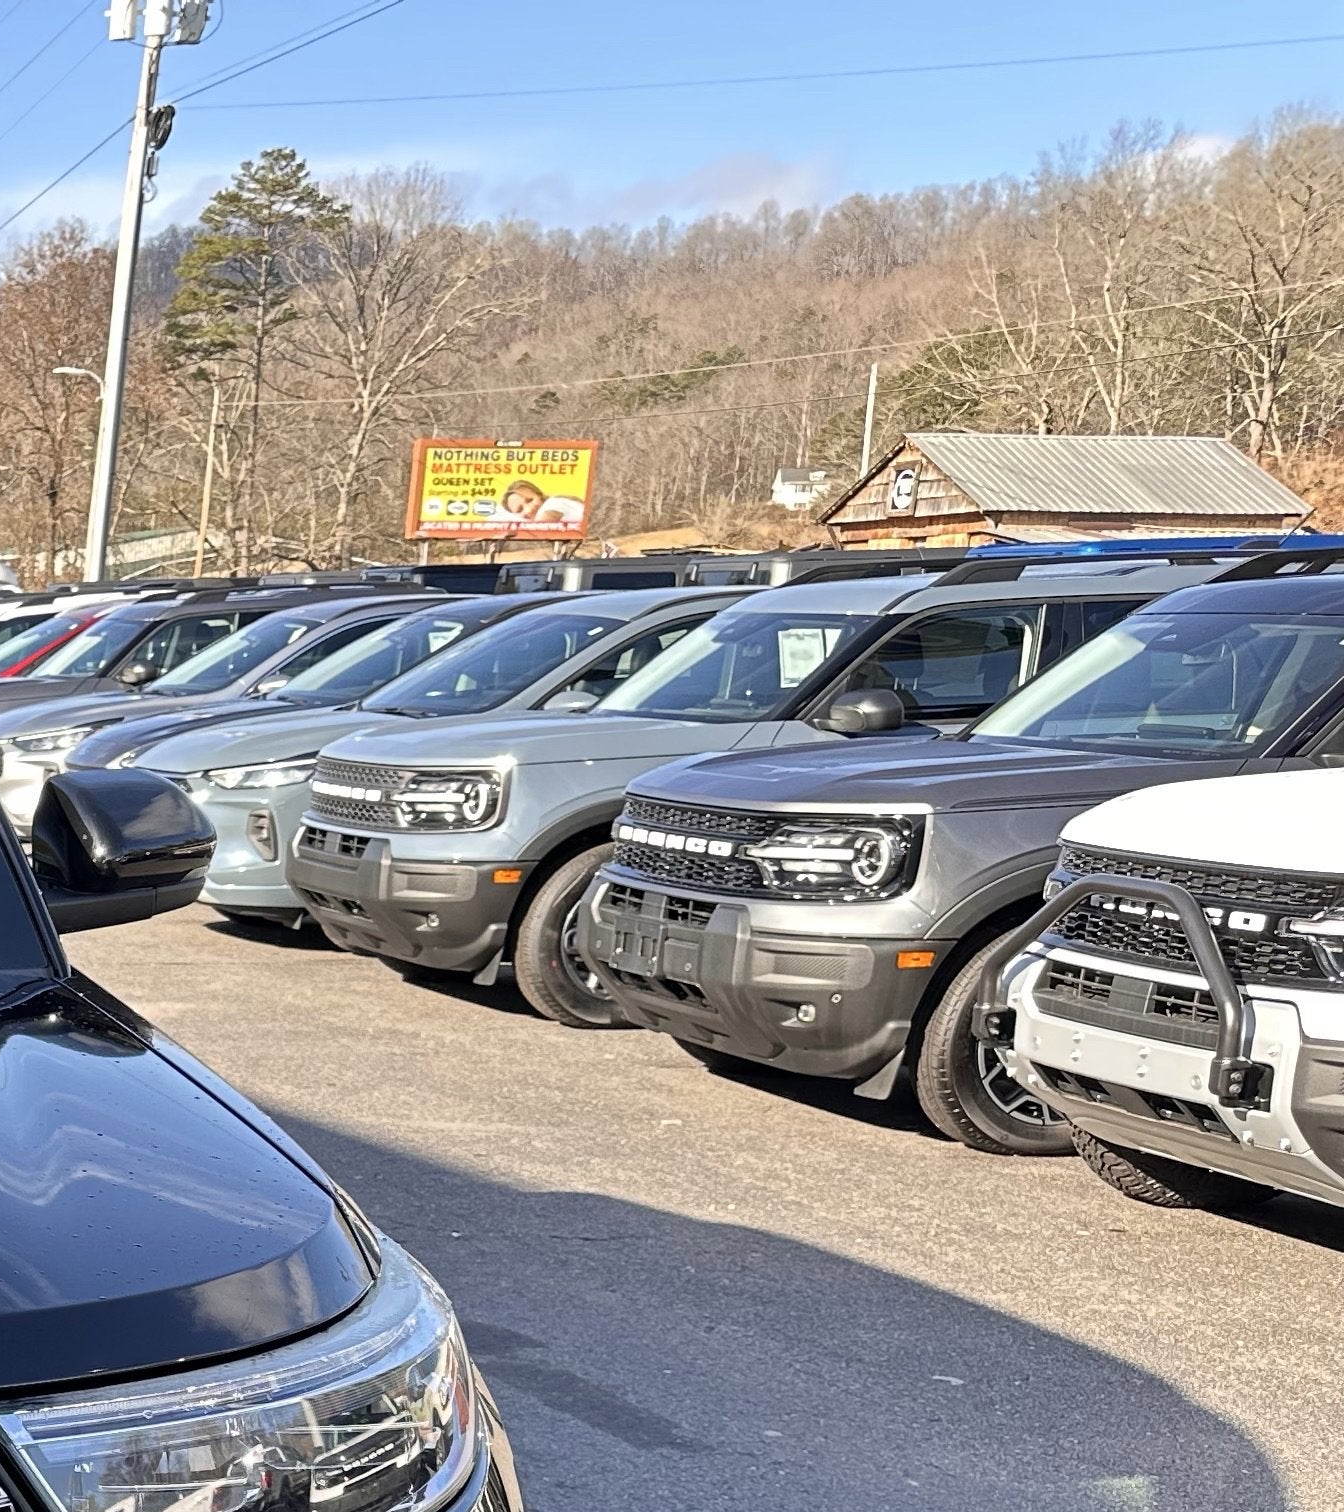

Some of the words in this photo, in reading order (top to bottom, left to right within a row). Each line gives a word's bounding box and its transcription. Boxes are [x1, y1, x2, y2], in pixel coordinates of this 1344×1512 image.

[432, 450, 501, 462] NOTHING
[506, 450, 536, 462] BUT
[540, 451, 580, 462] BEDS
[431, 463, 512, 475] MATTRESS
[517, 463, 578, 475] OUTLET
[432, 477, 471, 487] QUEEN
[473, 477, 494, 487] SET
